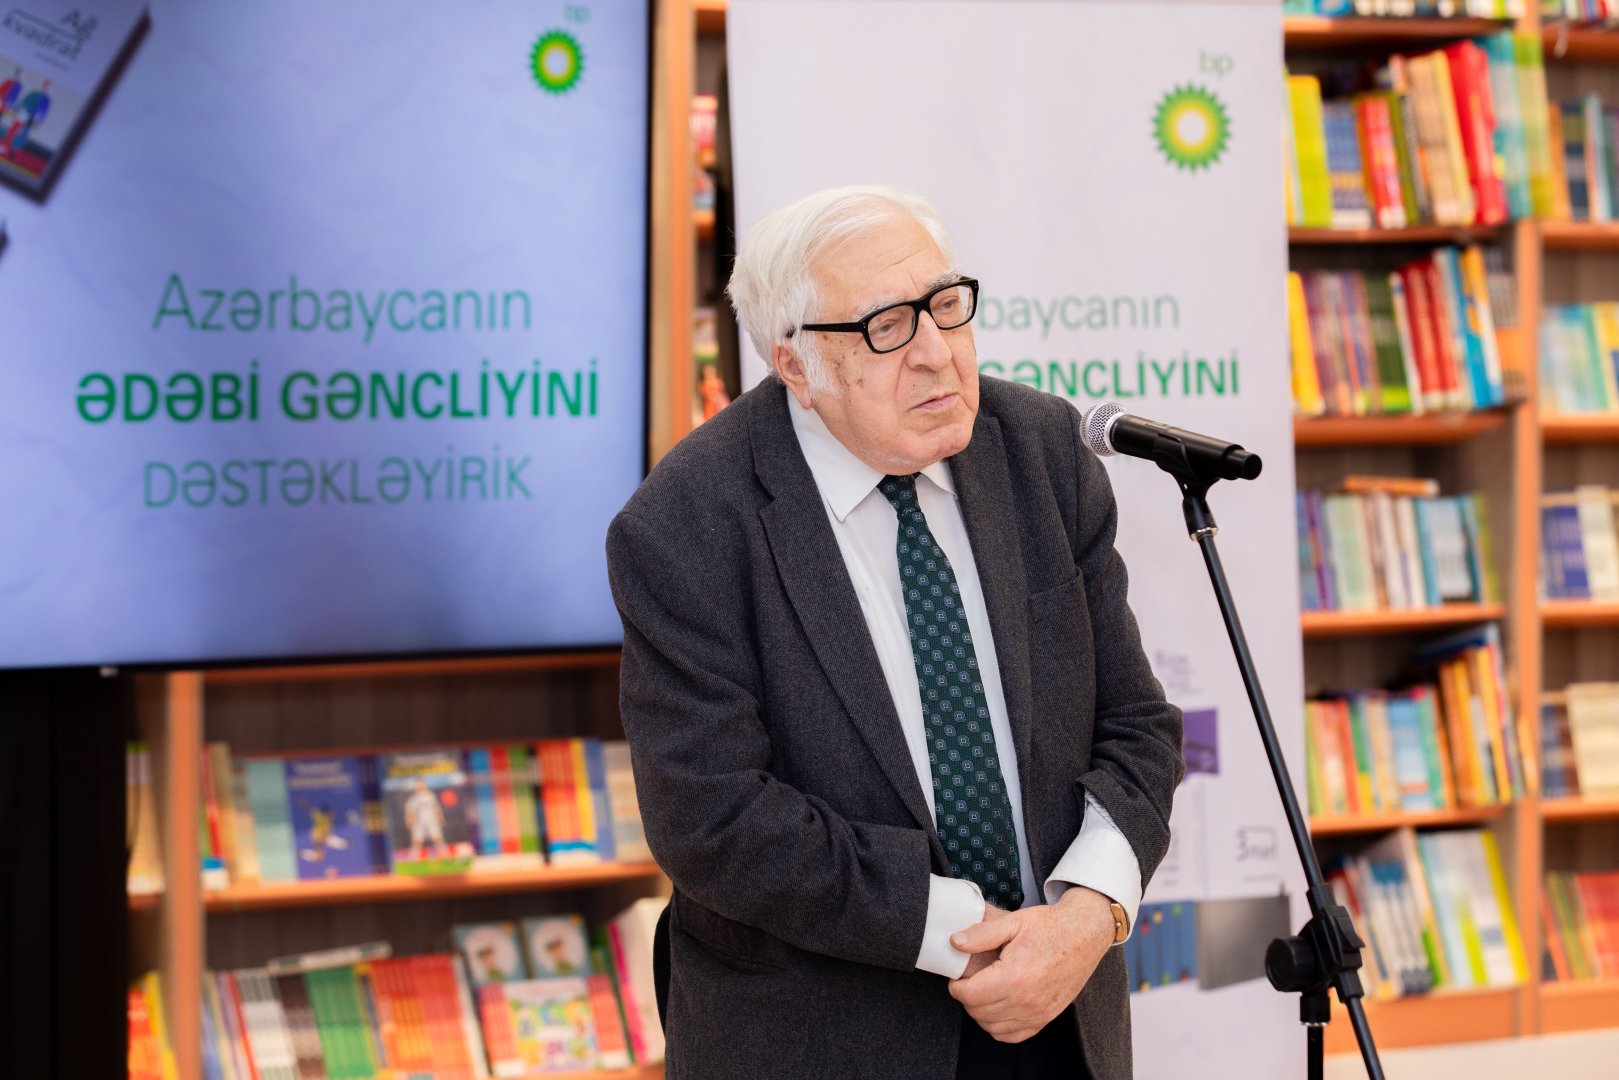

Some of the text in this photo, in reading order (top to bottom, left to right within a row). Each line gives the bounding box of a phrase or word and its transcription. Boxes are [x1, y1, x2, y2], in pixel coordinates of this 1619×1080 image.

[1199, 48, 1233, 80] bp
[151, 272, 533, 346] Azərbaycanın
[978, 286, 1180, 340] baycanın
[75, 358, 600, 425] ƏDƏBİ GƏNCLİYİNİ
[143, 444, 533, 511] DƏSTƏKLƏYİRİK
